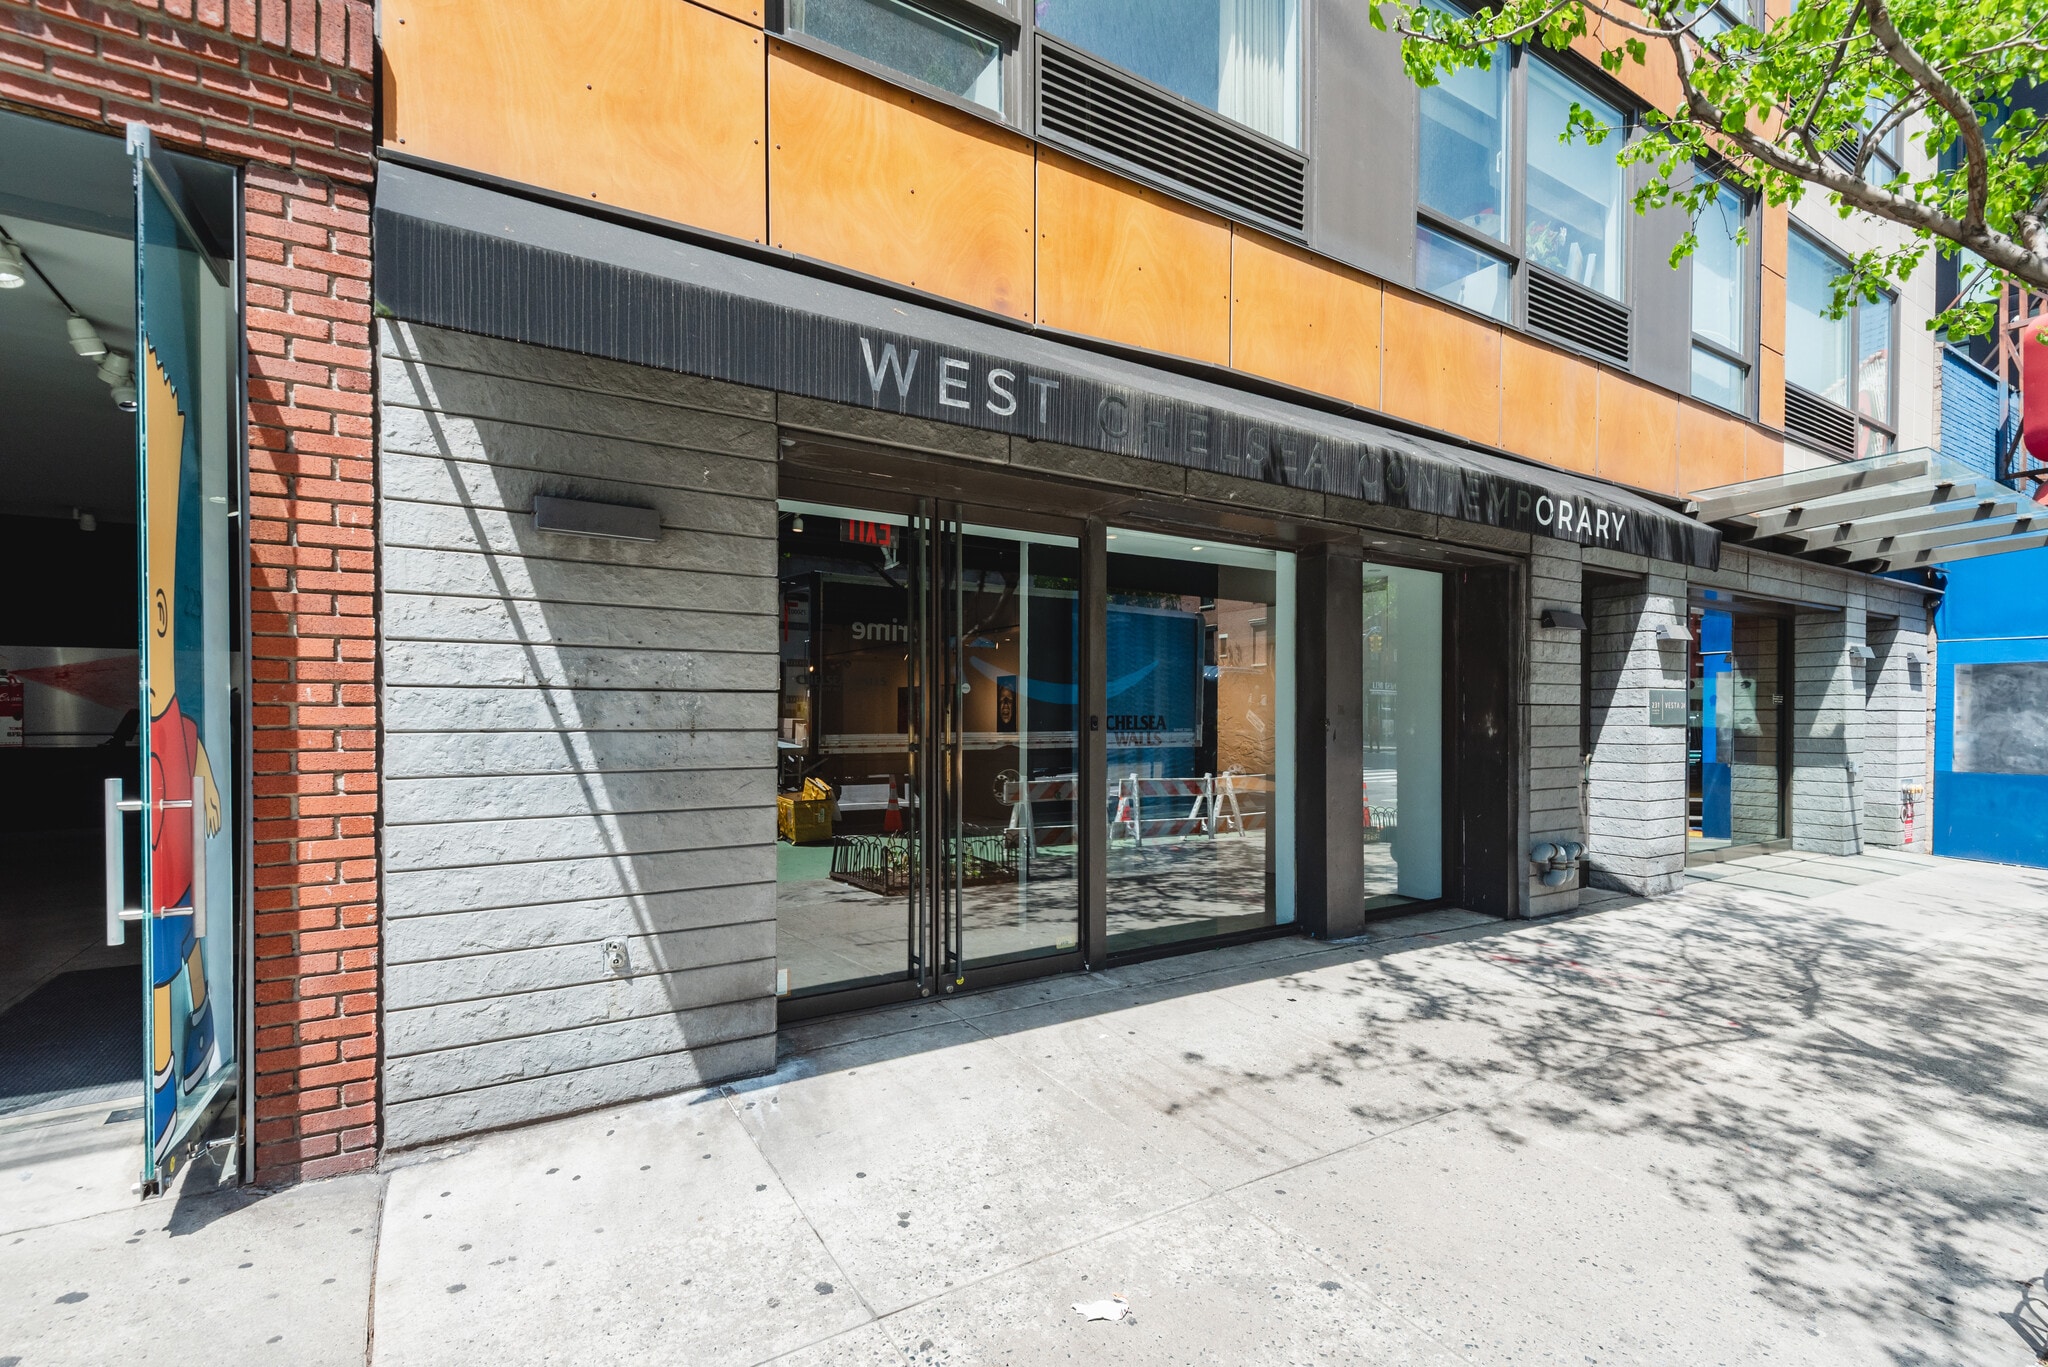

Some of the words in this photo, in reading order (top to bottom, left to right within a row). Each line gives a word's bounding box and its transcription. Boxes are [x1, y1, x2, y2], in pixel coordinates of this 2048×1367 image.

[859, 337, 1059, 424] WEST
[1098, 396, 1329, 481] CHELSEA
[1358, 452, 1626, 542] CONTEMPORARY
[1106, 714, 1167, 731] CHELSEA
[1114, 731, 1163, 747] WALLS
